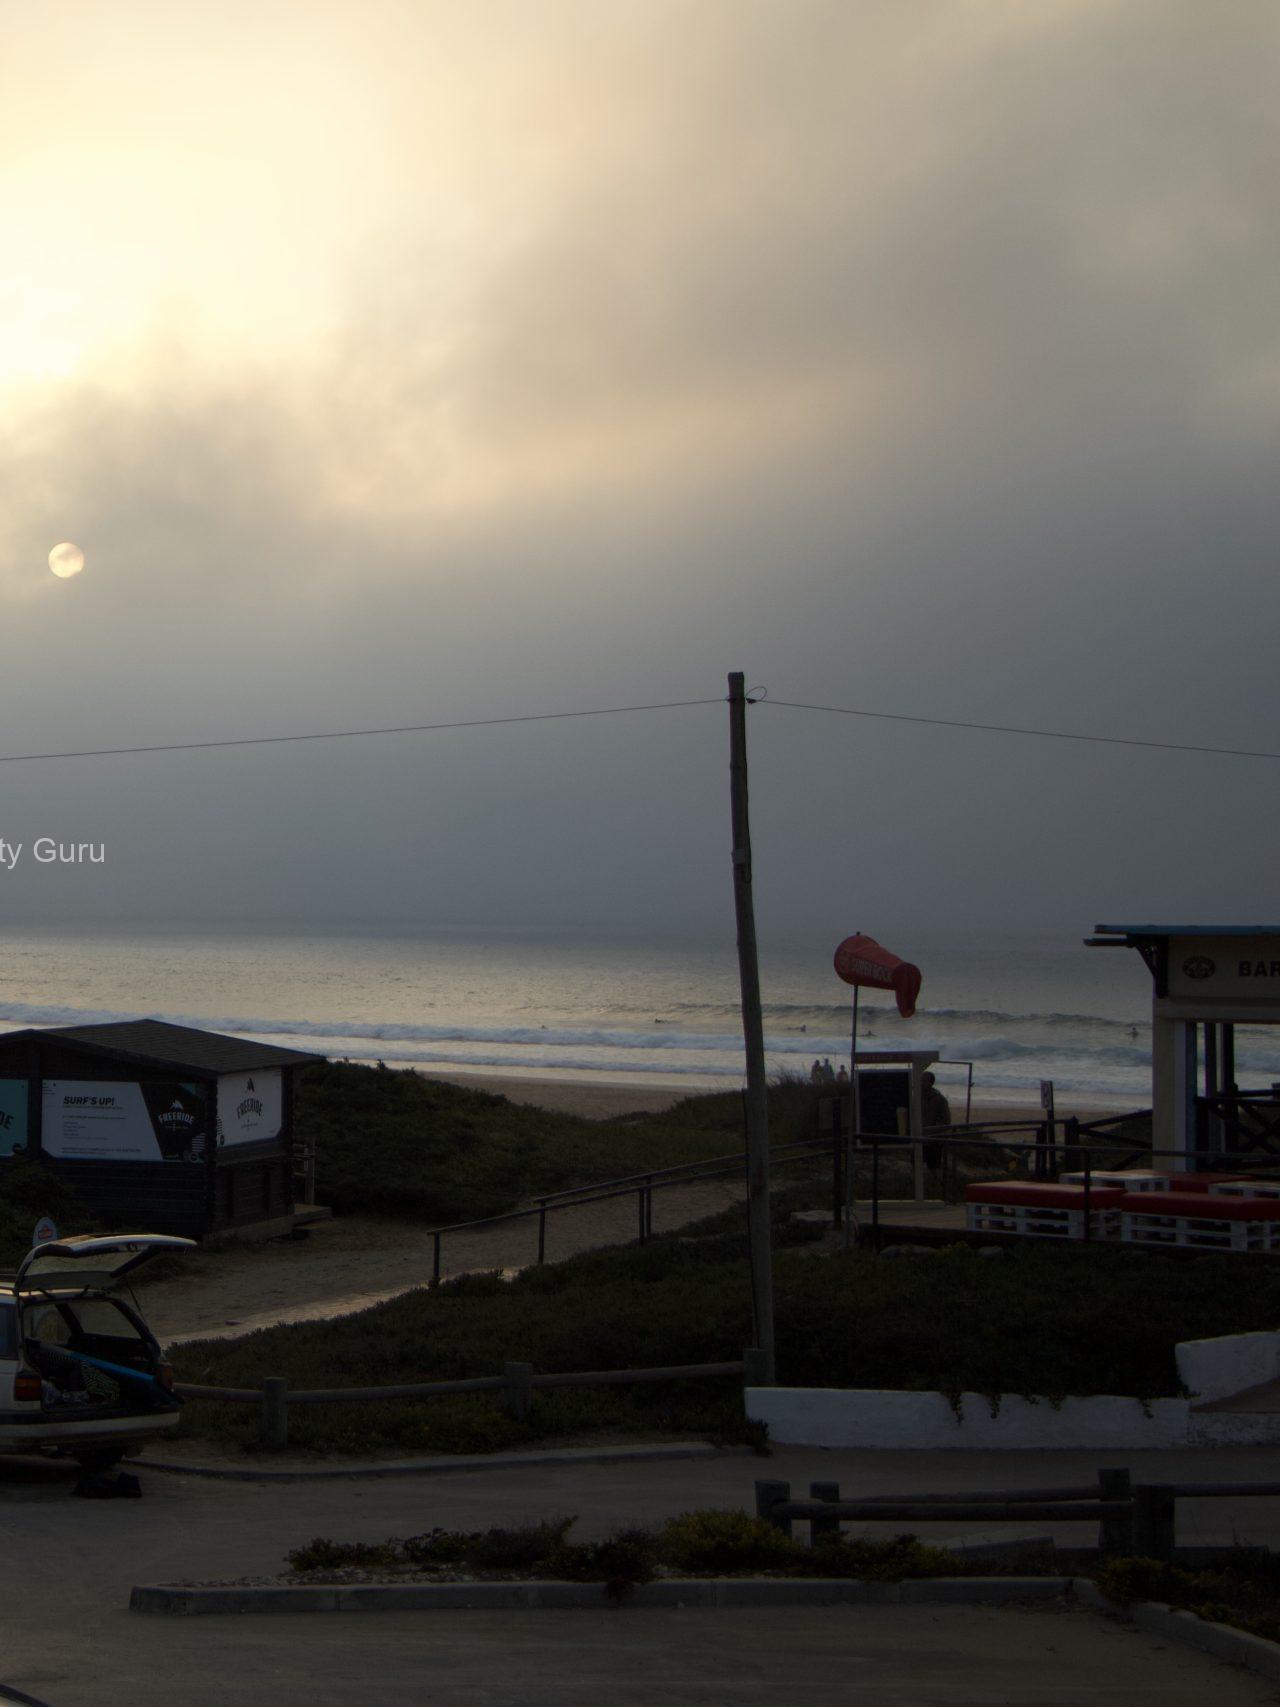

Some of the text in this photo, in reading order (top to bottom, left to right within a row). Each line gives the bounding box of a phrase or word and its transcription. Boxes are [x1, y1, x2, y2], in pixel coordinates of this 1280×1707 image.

[63, 1095, 115, 1106] SURF'S UP!
[158, 1111, 195, 1125] FREERIDE
